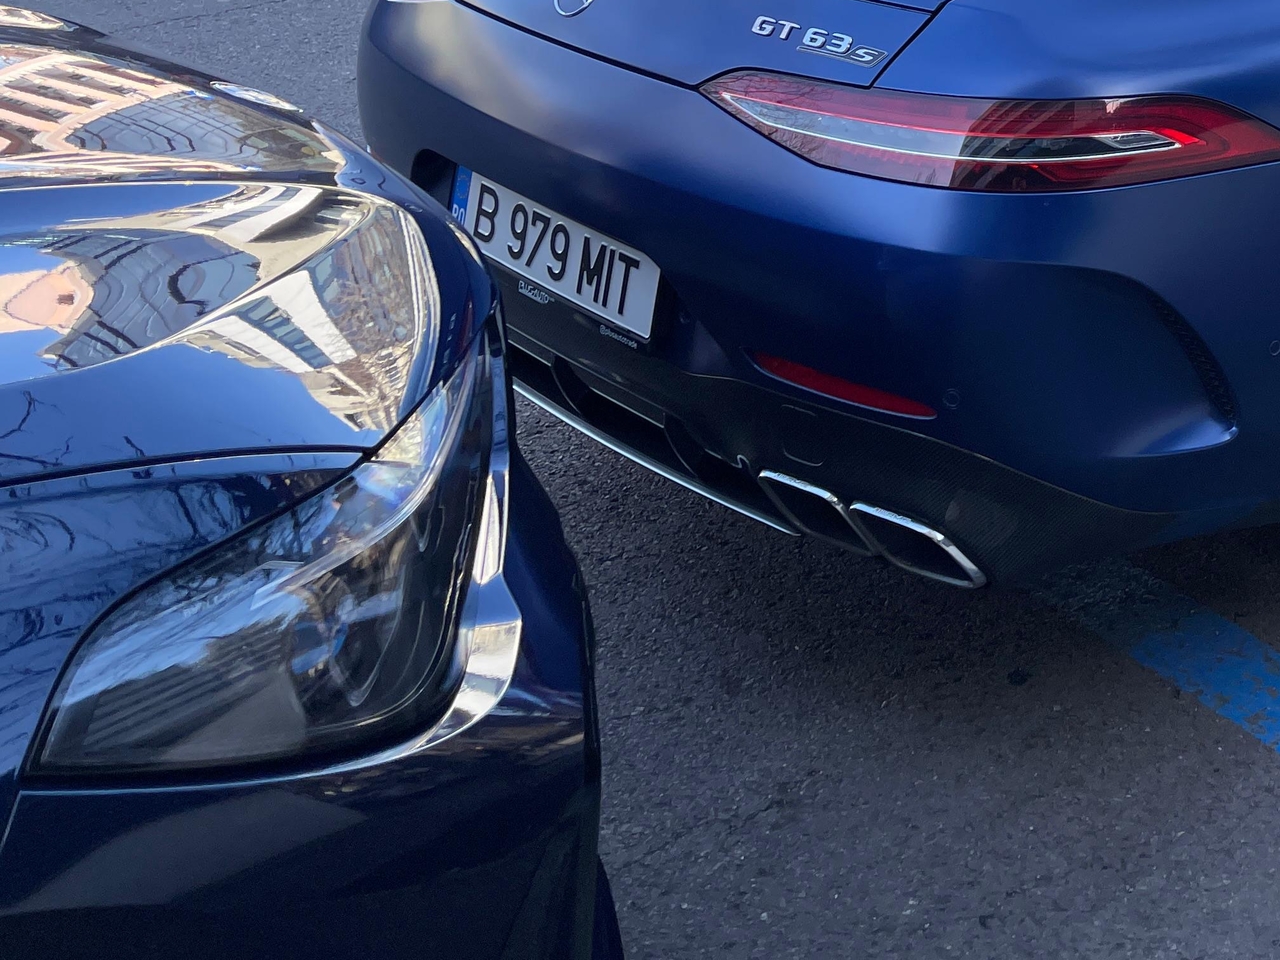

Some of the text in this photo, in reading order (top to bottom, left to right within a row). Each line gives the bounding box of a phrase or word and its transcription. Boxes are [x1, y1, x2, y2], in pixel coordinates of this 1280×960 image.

[751, 16, 801, 40] GT
[473, 181, 641, 316] B 979 MIT
